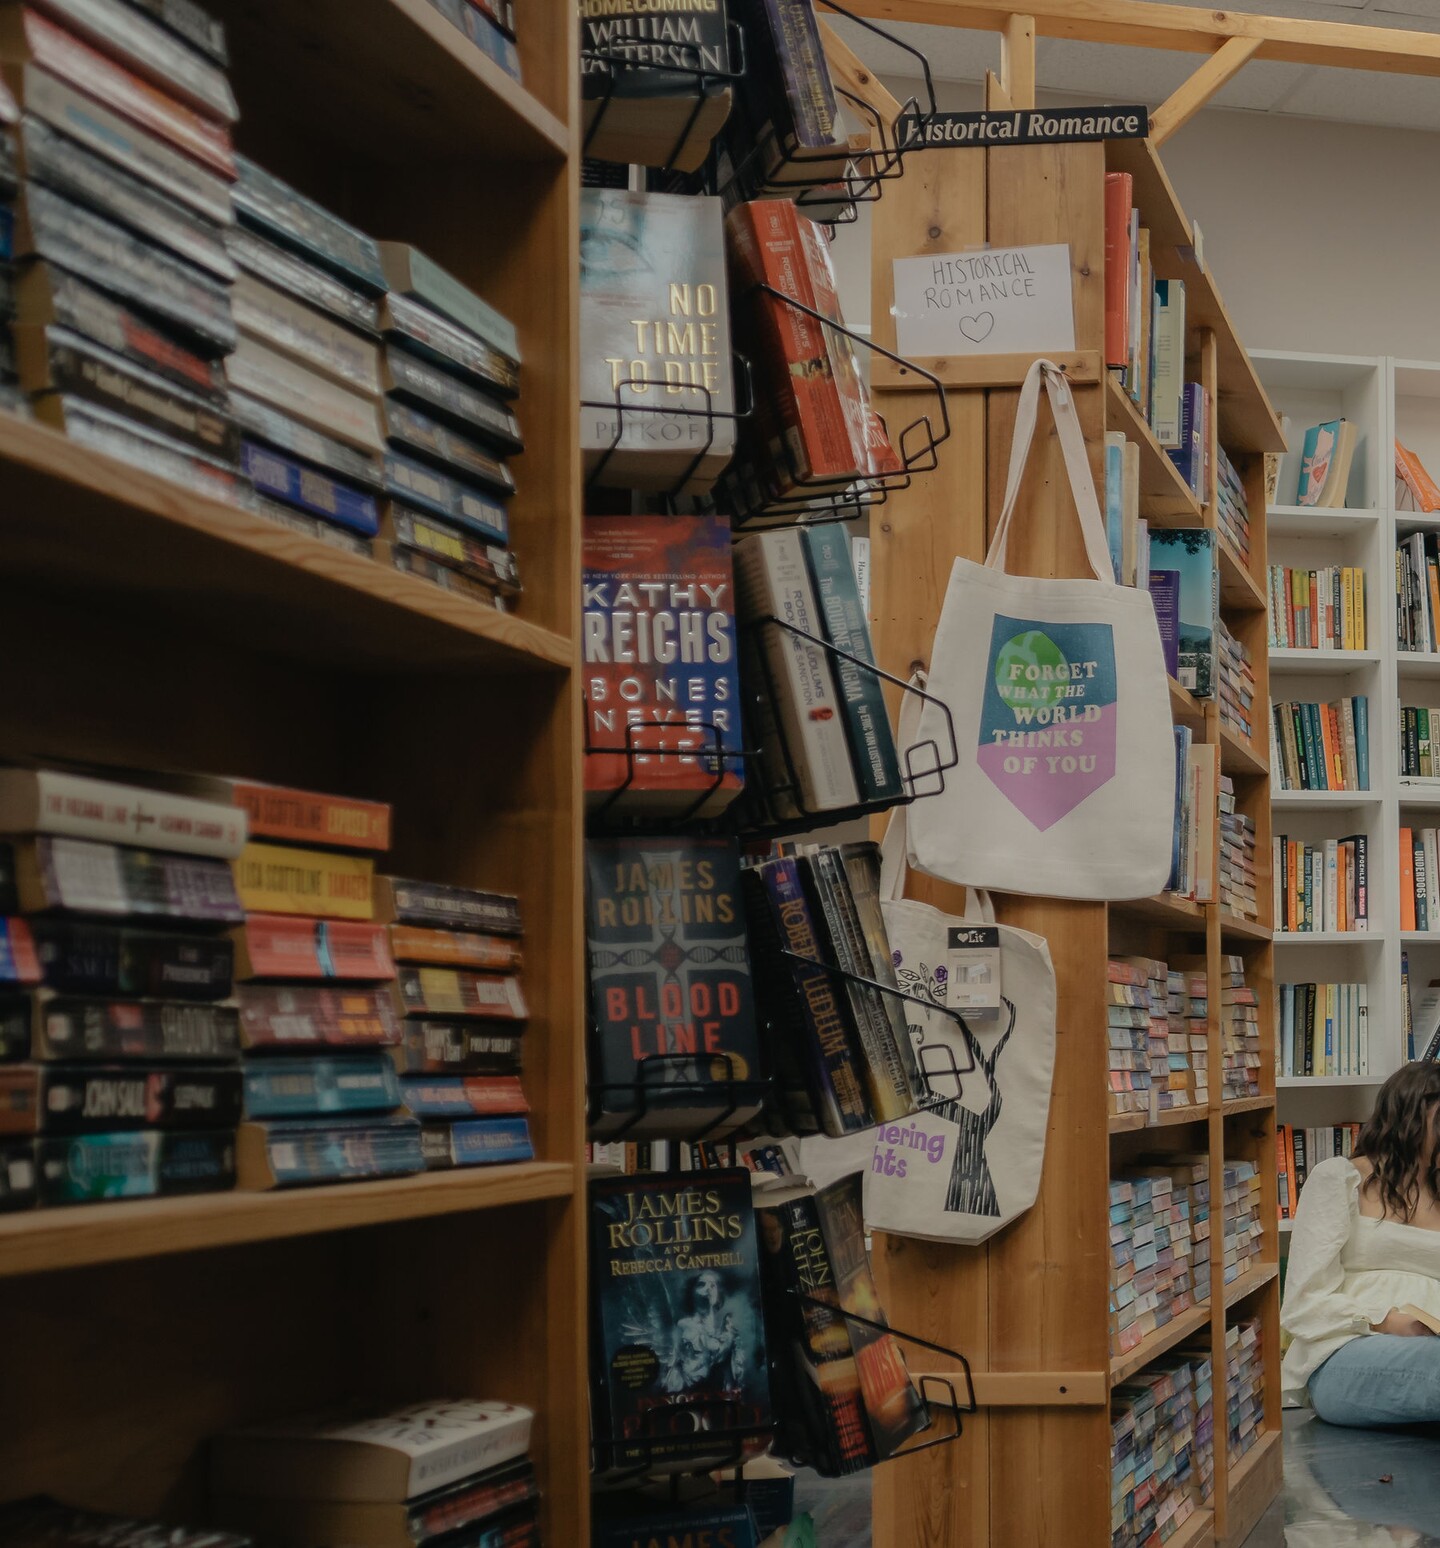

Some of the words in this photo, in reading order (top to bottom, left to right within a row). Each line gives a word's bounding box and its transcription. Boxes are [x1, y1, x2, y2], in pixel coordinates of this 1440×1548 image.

[589, 17, 702, 46] WILLIAM
[906, 113, 1020, 141] Historical
[1027, 113, 1139, 137] Romance
[933, 253, 1036, 285] HISTORICAL
[669, 283, 717, 317] NO
[778, 275, 793, 314] BOUNE
[781, 256, 798, 297] ROBERT
[793, 297, 811, 350] LDLUM'S
[924, 278, 1036, 309] ROMANCE
[630, 319, 718, 355] TIME
[605, 358, 650, 395] TO
[664, 361, 720, 395] DIE
[595, 421, 716, 441] PETKOF
[583, 583, 728, 608] KATHY
[819, 576, 834, 595] The
[584, 611, 731, 664] REICHS
[783, 601, 801, 654] BOUNE
[826, 595, 852, 651] BOURNE
[793, 589, 812, 641] ROBER
[805, 644, 826, 698] LUDLUM'S
[1009, 661, 1098, 681] FORGET
[590, 677, 729, 701] BONES
[999, 685, 1051, 699] WHAT
[1054, 685, 1085, 698] THE
[594, 709, 729, 732] NEVER
[1013, 704, 1102, 725] WORLD
[633, 739, 696, 764] LIE
[865, 731, 877, 746] VAN
[992, 729, 1083, 748] THINKS
[867, 747, 888, 788] LUSTBADER
[1003, 756, 1038, 774] OF
[1046, 755, 1097, 773] YOU
[615, 860, 716, 894] JAMES
[1305, 875, 1313, 905] Patterson
[1415, 850, 1427, 899] UNDERDOGS
[598, 894, 736, 928] ROLLINS
[968, 931, 985, 943] Lit
[606, 982, 741, 1022] BLOOD
[802, 972, 849, 1057] LUDLUM
[630, 1022, 725, 1061] LINE
[83, 1080, 118, 1117] JOHN
[1294, 1134, 1303, 1150] ELON
[1295, 1150, 1305, 1167] MUSK
[623, 1188, 722, 1225] JAMES
[608, 1215, 743, 1249] ROLLINS
[611, 1258, 673, 1277] REBECCA
[675, 1251, 745, 1271] CANTRELL
[664, 1245, 691, 1255] AND
[802, 1227, 832, 1285] JOHN
